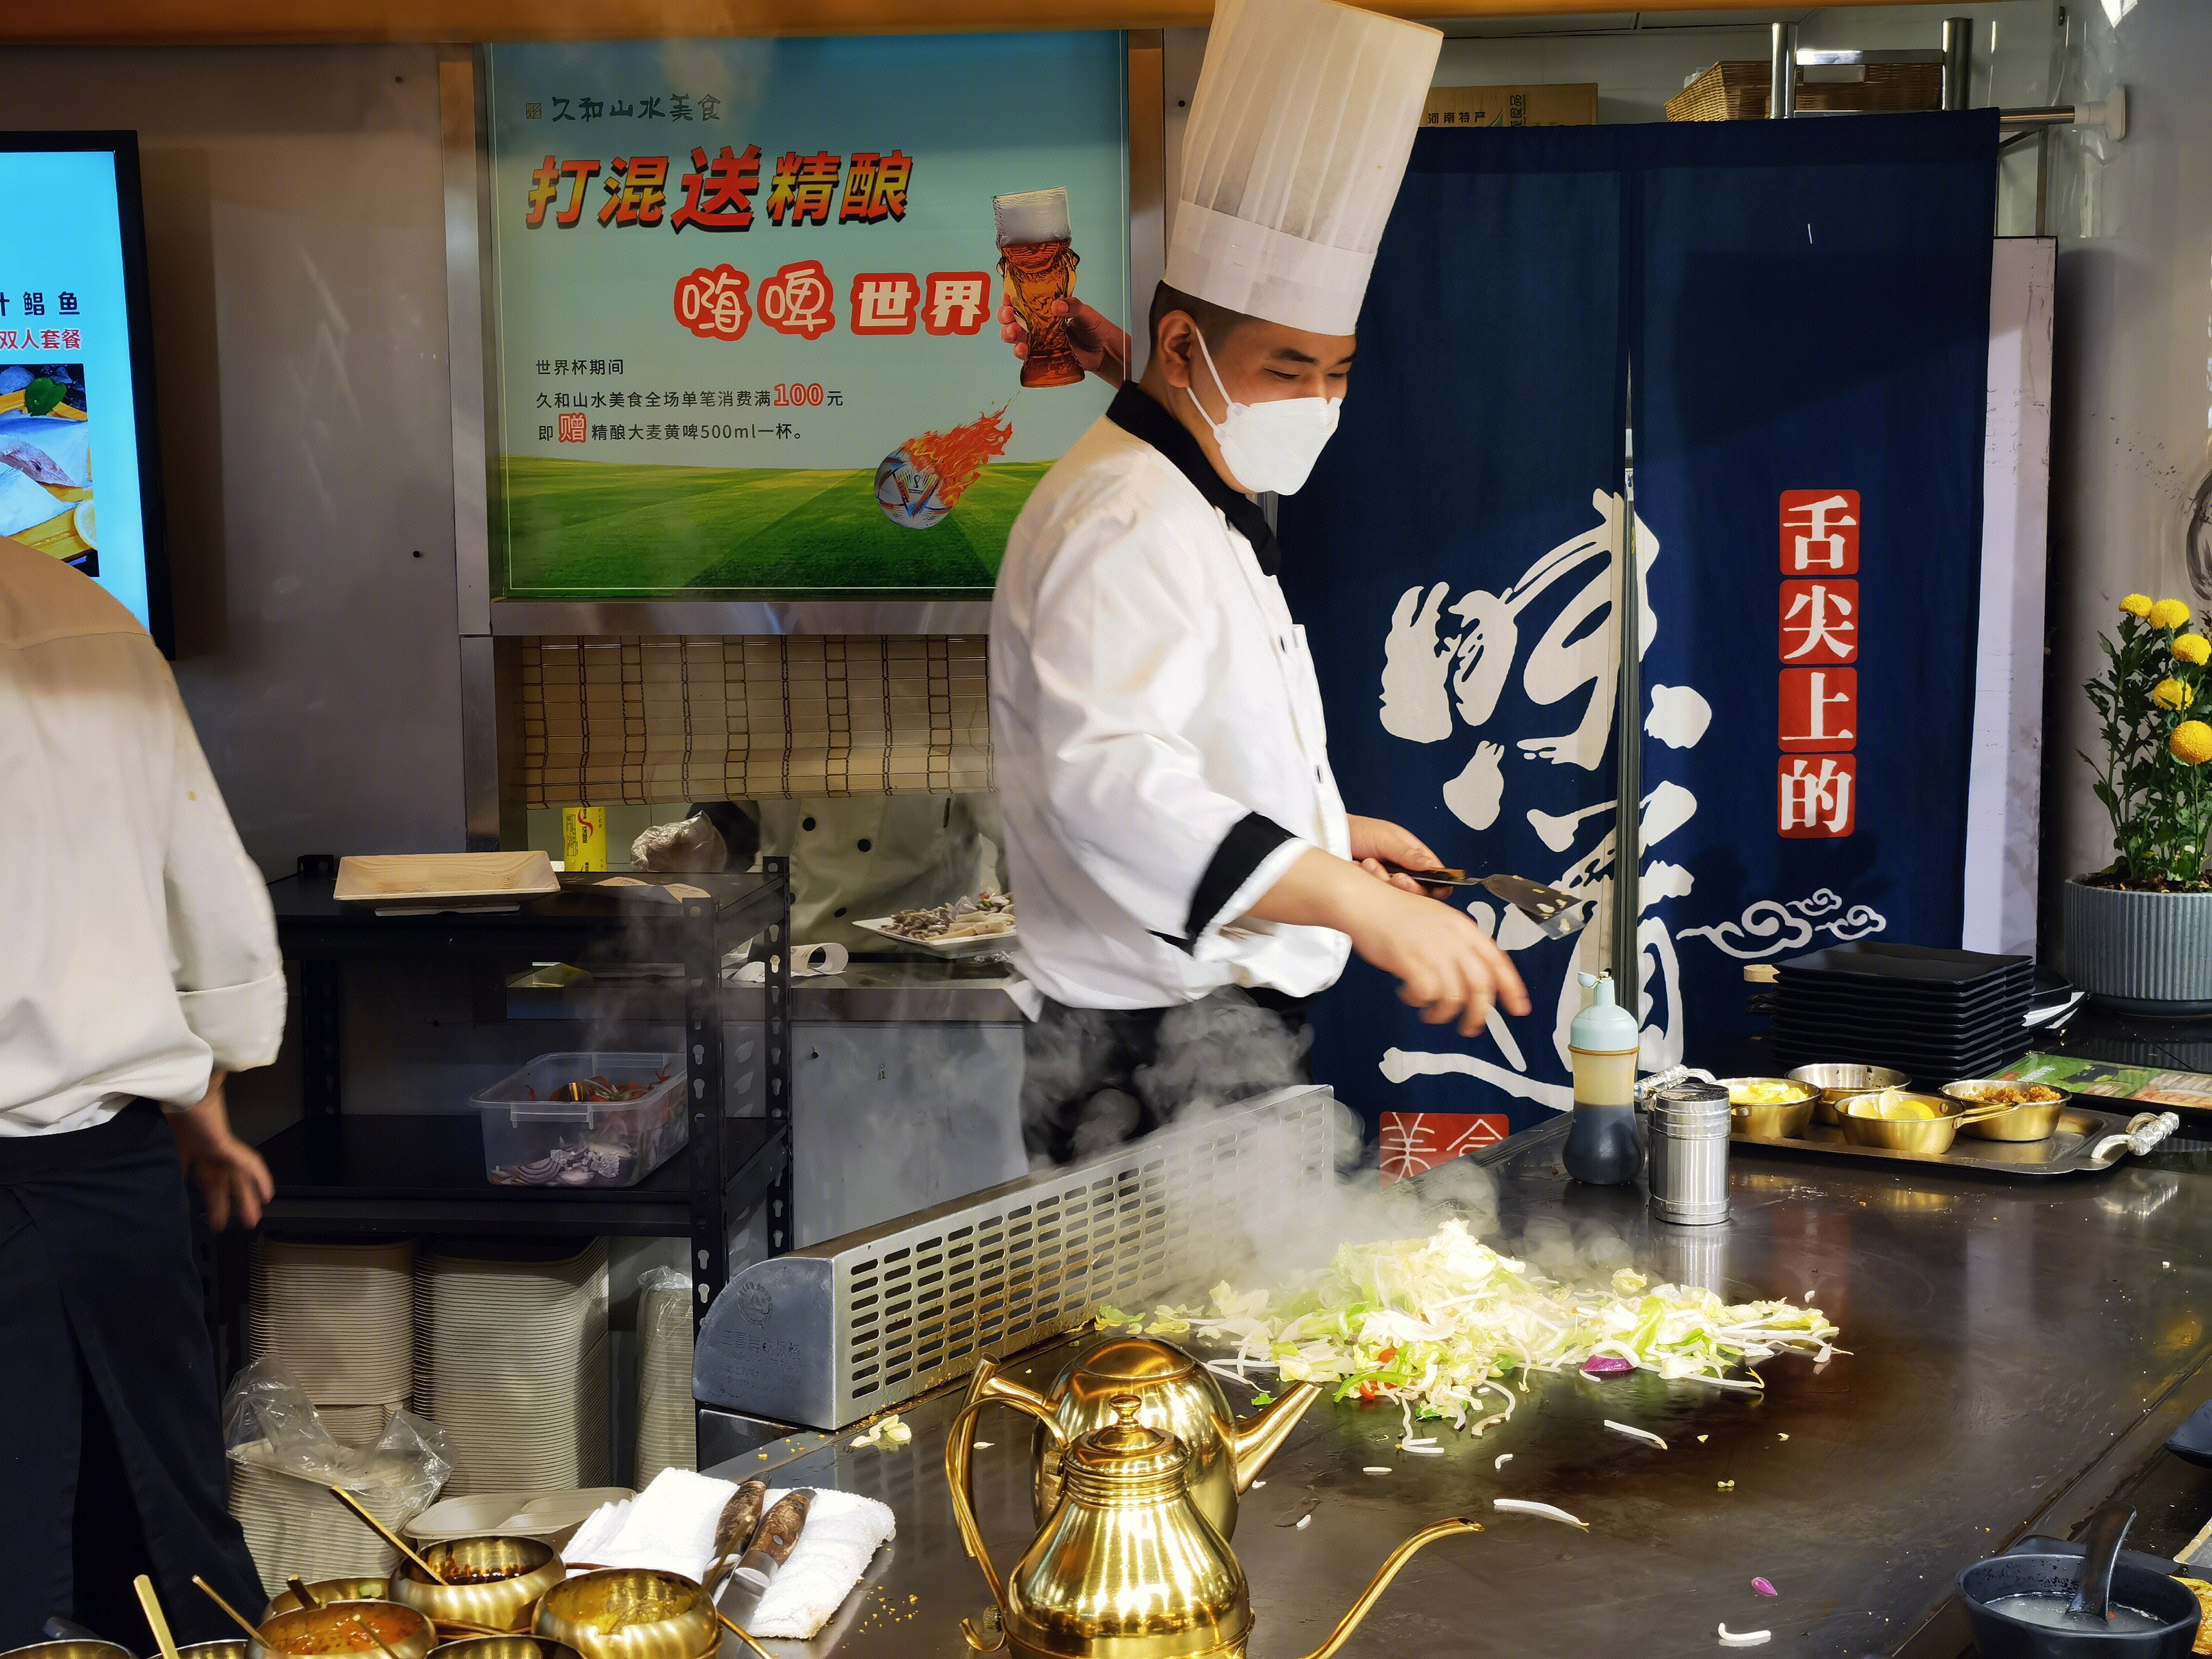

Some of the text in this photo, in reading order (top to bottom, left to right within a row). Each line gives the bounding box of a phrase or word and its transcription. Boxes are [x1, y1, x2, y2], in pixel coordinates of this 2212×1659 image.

[552, 93, 721, 122] 久和山水美食
[525, 144, 913, 234] 打混送精酿
[678, 264, 987, 337] 嗨啤世界
[0, 329, 81, 349] 双人套餐
[535, 359, 624, 375] 世界杯期间
[536, 382, 844, 409] 久和山水美食全场单笔消费满100元
[1779, 494, 1858, 833] 舌尖上的
